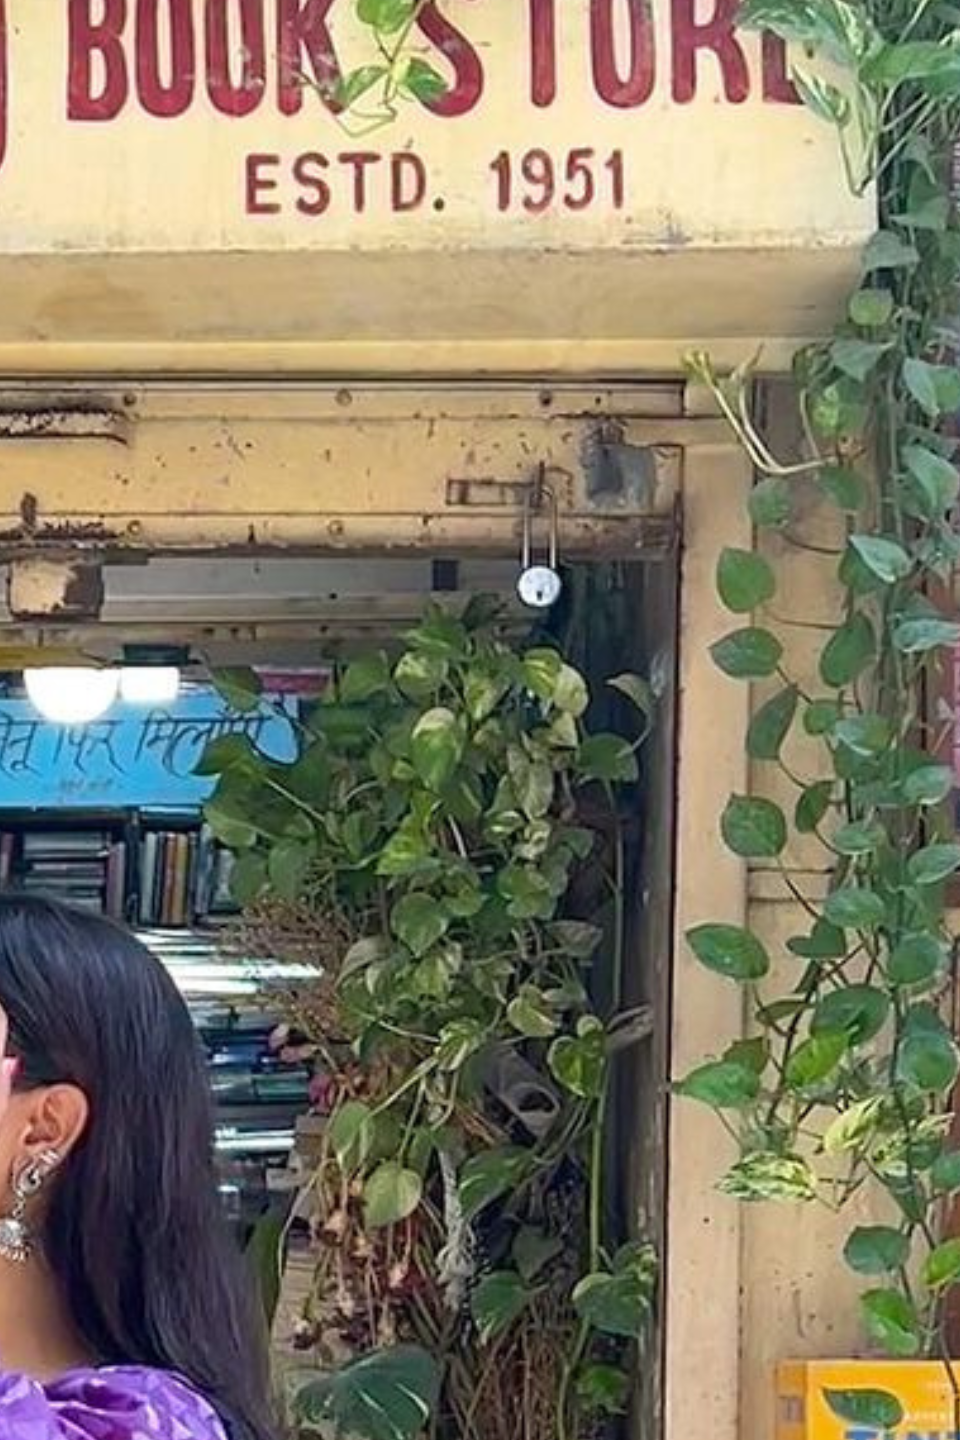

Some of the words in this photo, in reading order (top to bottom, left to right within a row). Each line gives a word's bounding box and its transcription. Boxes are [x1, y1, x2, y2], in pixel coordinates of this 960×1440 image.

[66, 0, 350, 120] BOOK
[245, 151, 445, 215] ESTD.
[489, 148, 626, 214] 1951
